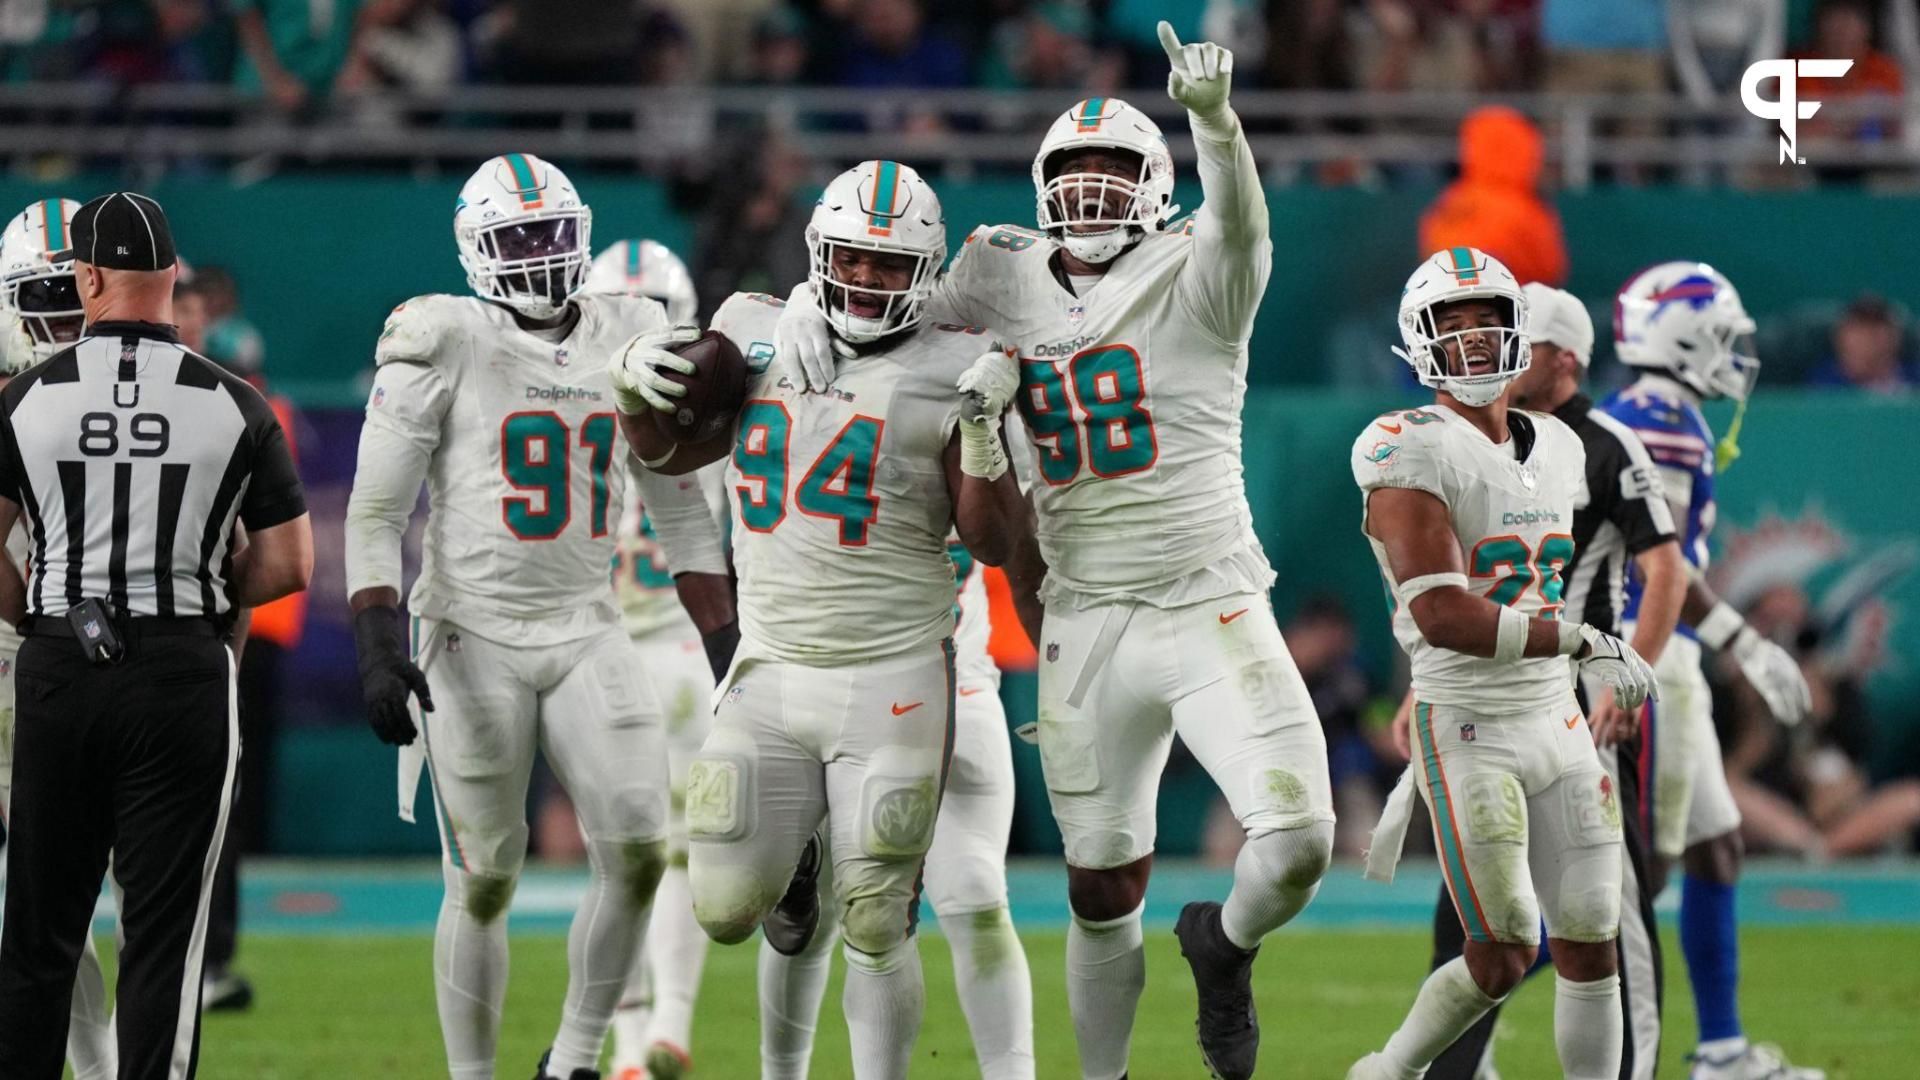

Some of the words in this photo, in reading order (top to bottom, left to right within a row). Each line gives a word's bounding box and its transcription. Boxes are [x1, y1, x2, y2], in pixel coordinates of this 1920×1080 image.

[117, 246, 129, 255] BL
[1034, 330, 1104, 357] Dolphin
[113, 384, 139, 408] U
[526, 386, 602, 403] Dolphins
[1018, 344, 1159, 486] 98
[78, 412, 170, 458] 89
[501, 410, 617, 541] 91
[732, 400, 885, 546] 94
